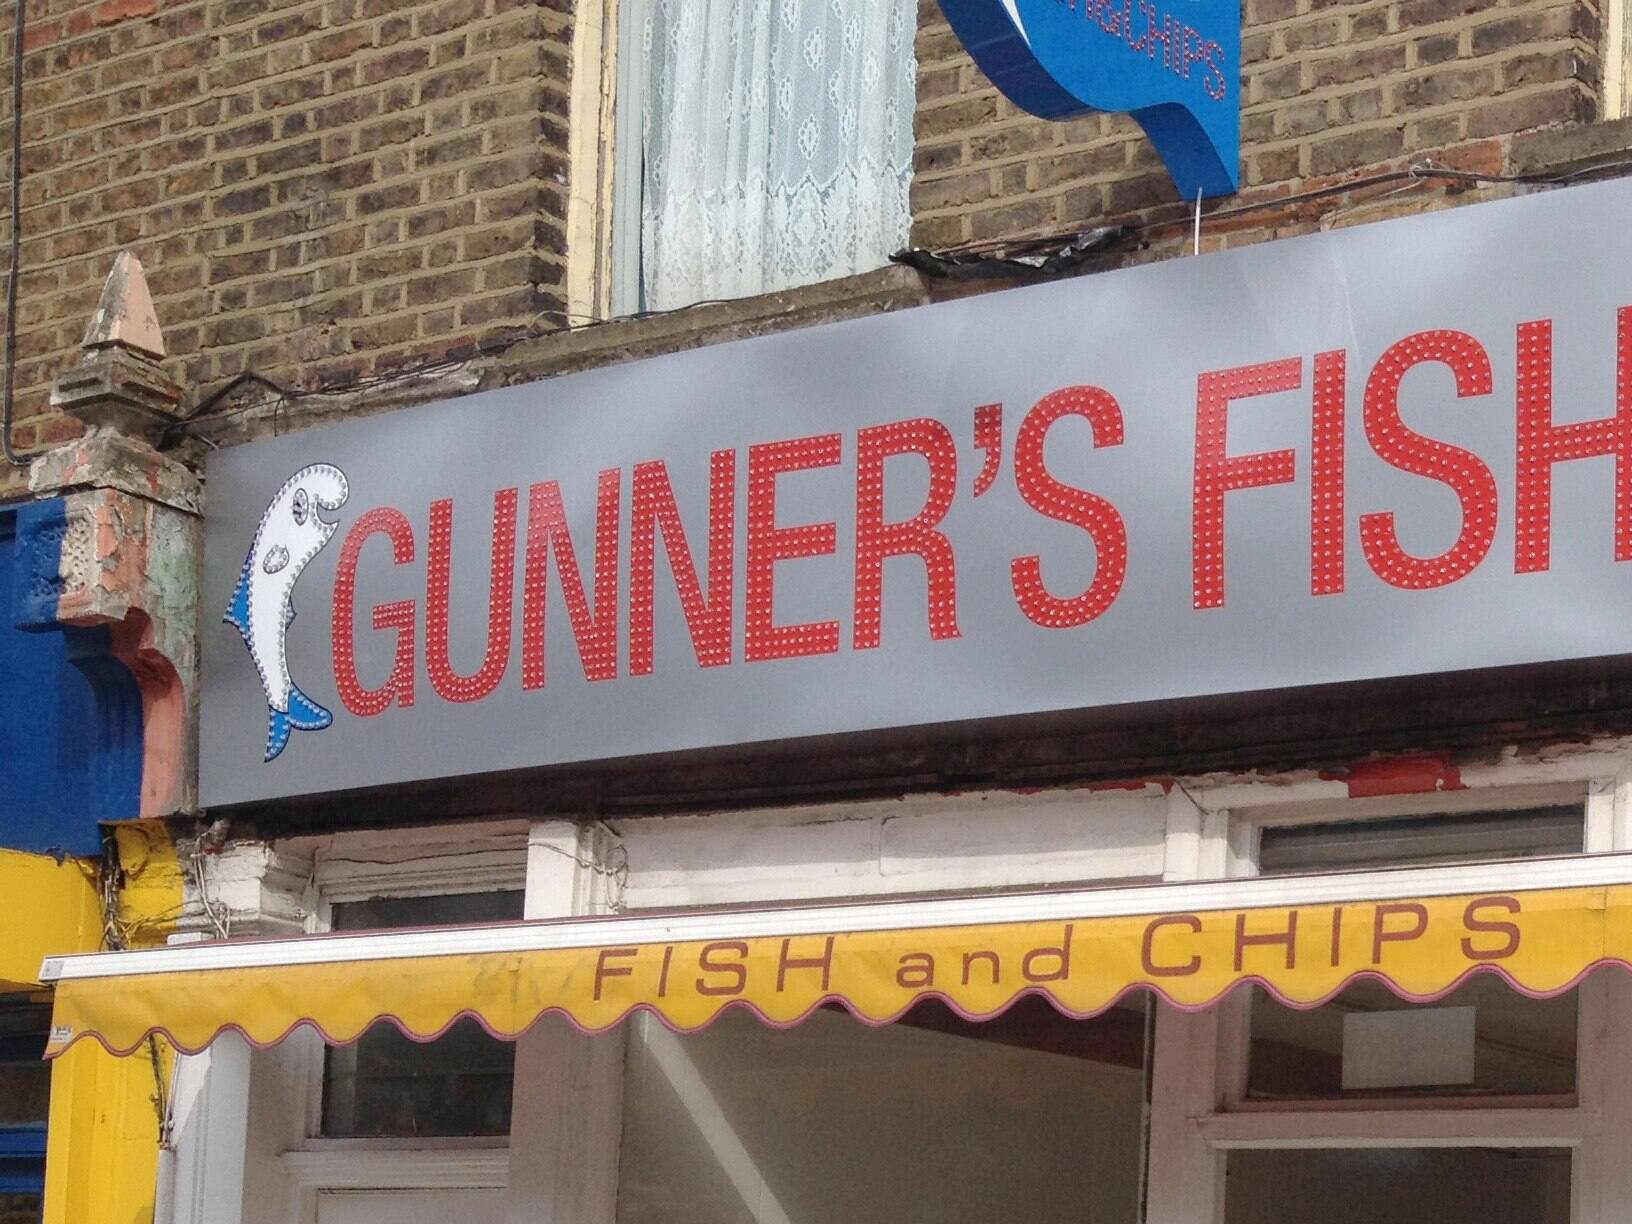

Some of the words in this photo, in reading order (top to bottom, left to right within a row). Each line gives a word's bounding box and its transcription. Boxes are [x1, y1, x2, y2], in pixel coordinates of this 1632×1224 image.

[330, 384, 1128, 717] GUNNER'S
[593, 936, 835, 1001] FISH
[895, 924, 1073, 988] and
[1141, 896, 1521, 977] CHIPS
